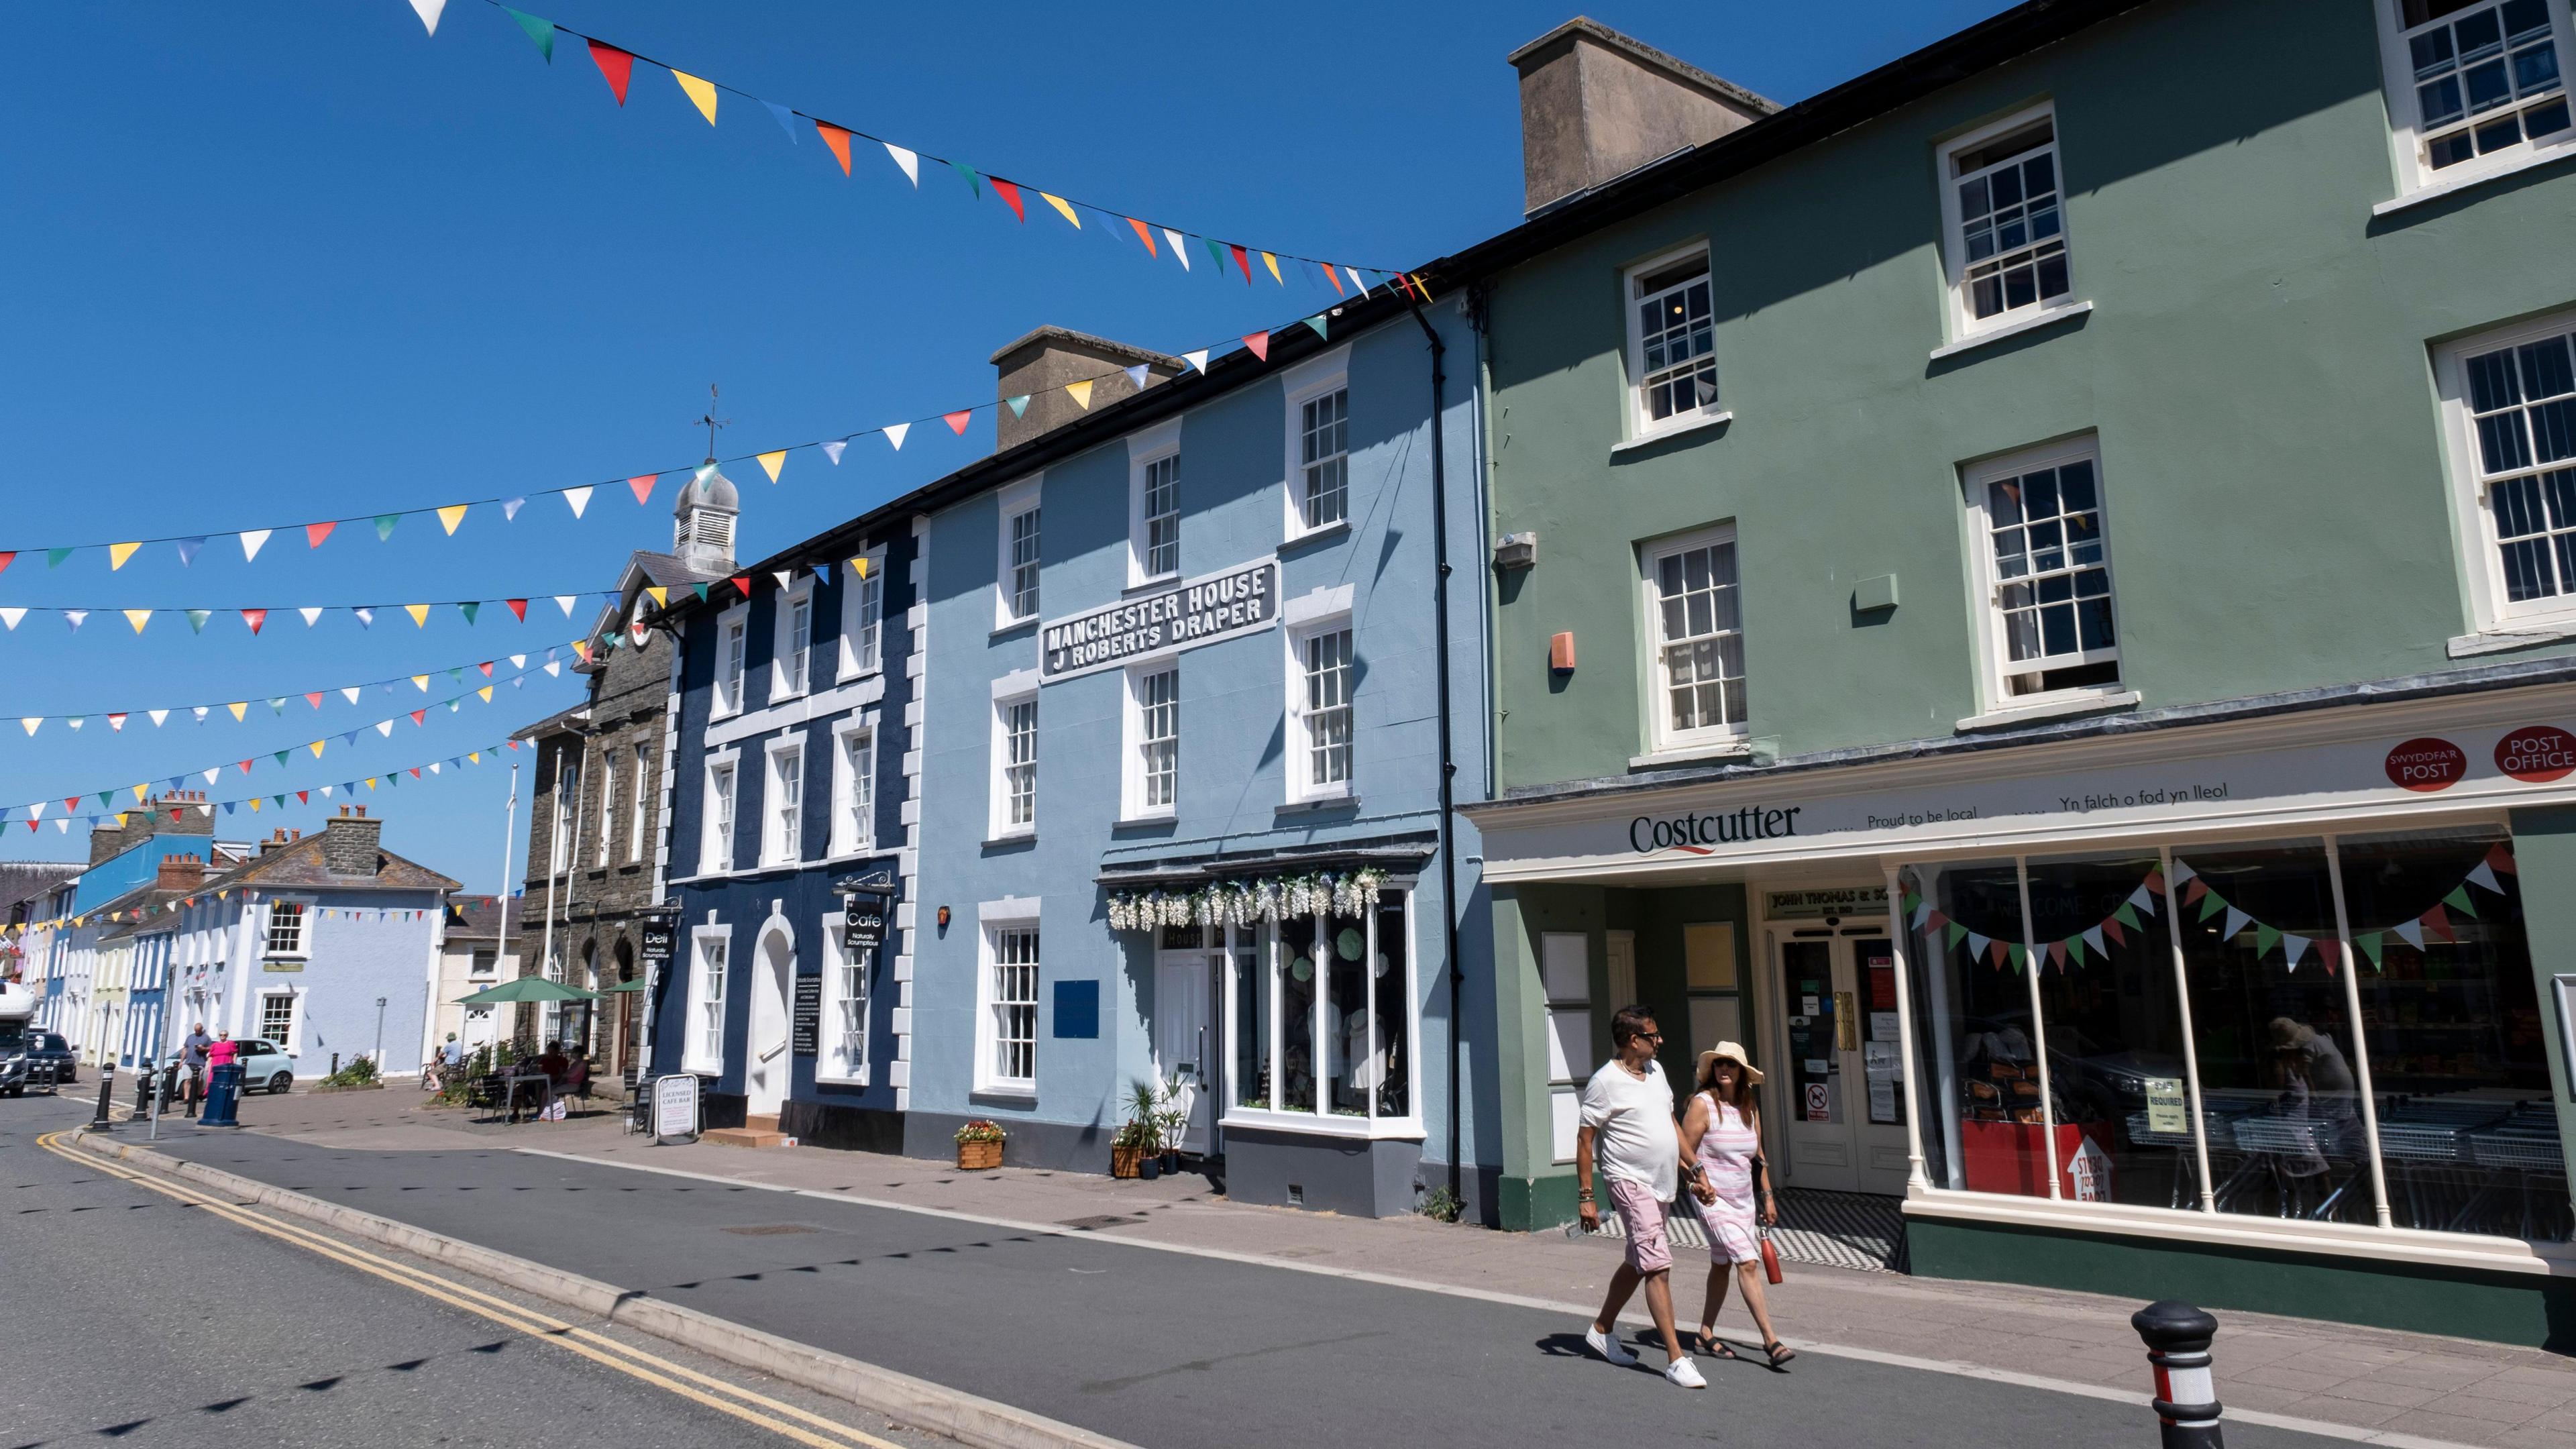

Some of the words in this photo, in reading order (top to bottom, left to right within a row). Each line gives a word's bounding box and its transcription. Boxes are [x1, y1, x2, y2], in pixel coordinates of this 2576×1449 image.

[1049, 594, 1179, 651] MANCHESTER
[1188, 568, 1265, 613] HOUSE
[1053, 651, 1064, 670] J
[1072, 627, 1161, 665] ROBERTS
[1172, 598, 1261, 641] DRAPER
[2510, 735, 2563, 755] POST
[2390, 749, 2457, 765] SWYDDFA'R
[2504, 751, 2575, 771] OFFICE
[2402, 763, 2451, 780] POST
[1868, 814, 1904, 828] Proud
[1909, 813, 1923, 825] to
[1927, 810, 1943, 823] be
[1947, 806, 1977, 821] local
[2059, 797, 2080, 812] Yn
[2085, 793, 2118, 810] falch
[2124, 798, 2134, 807] o
[2139, 789, 2163, 806] fod
[2170, 789, 2188, 805] yn
[2194, 784, 2228, 800] lleol
[1629, 806, 1802, 853] Costcutter
[1772, 894, 1803, 908] JOHN
[1805, 891, 1856, 904] THOMAS
[1874, 889, 1888, 900] SO
[1997, 896, 2085, 917] WECOME
[847, 913, 881, 927] Cafe
[645, 932, 668, 943] Deli
[2150, 1097, 2183, 1106] REQUIRED
[2078, 1155, 2104, 1175] DEALS
